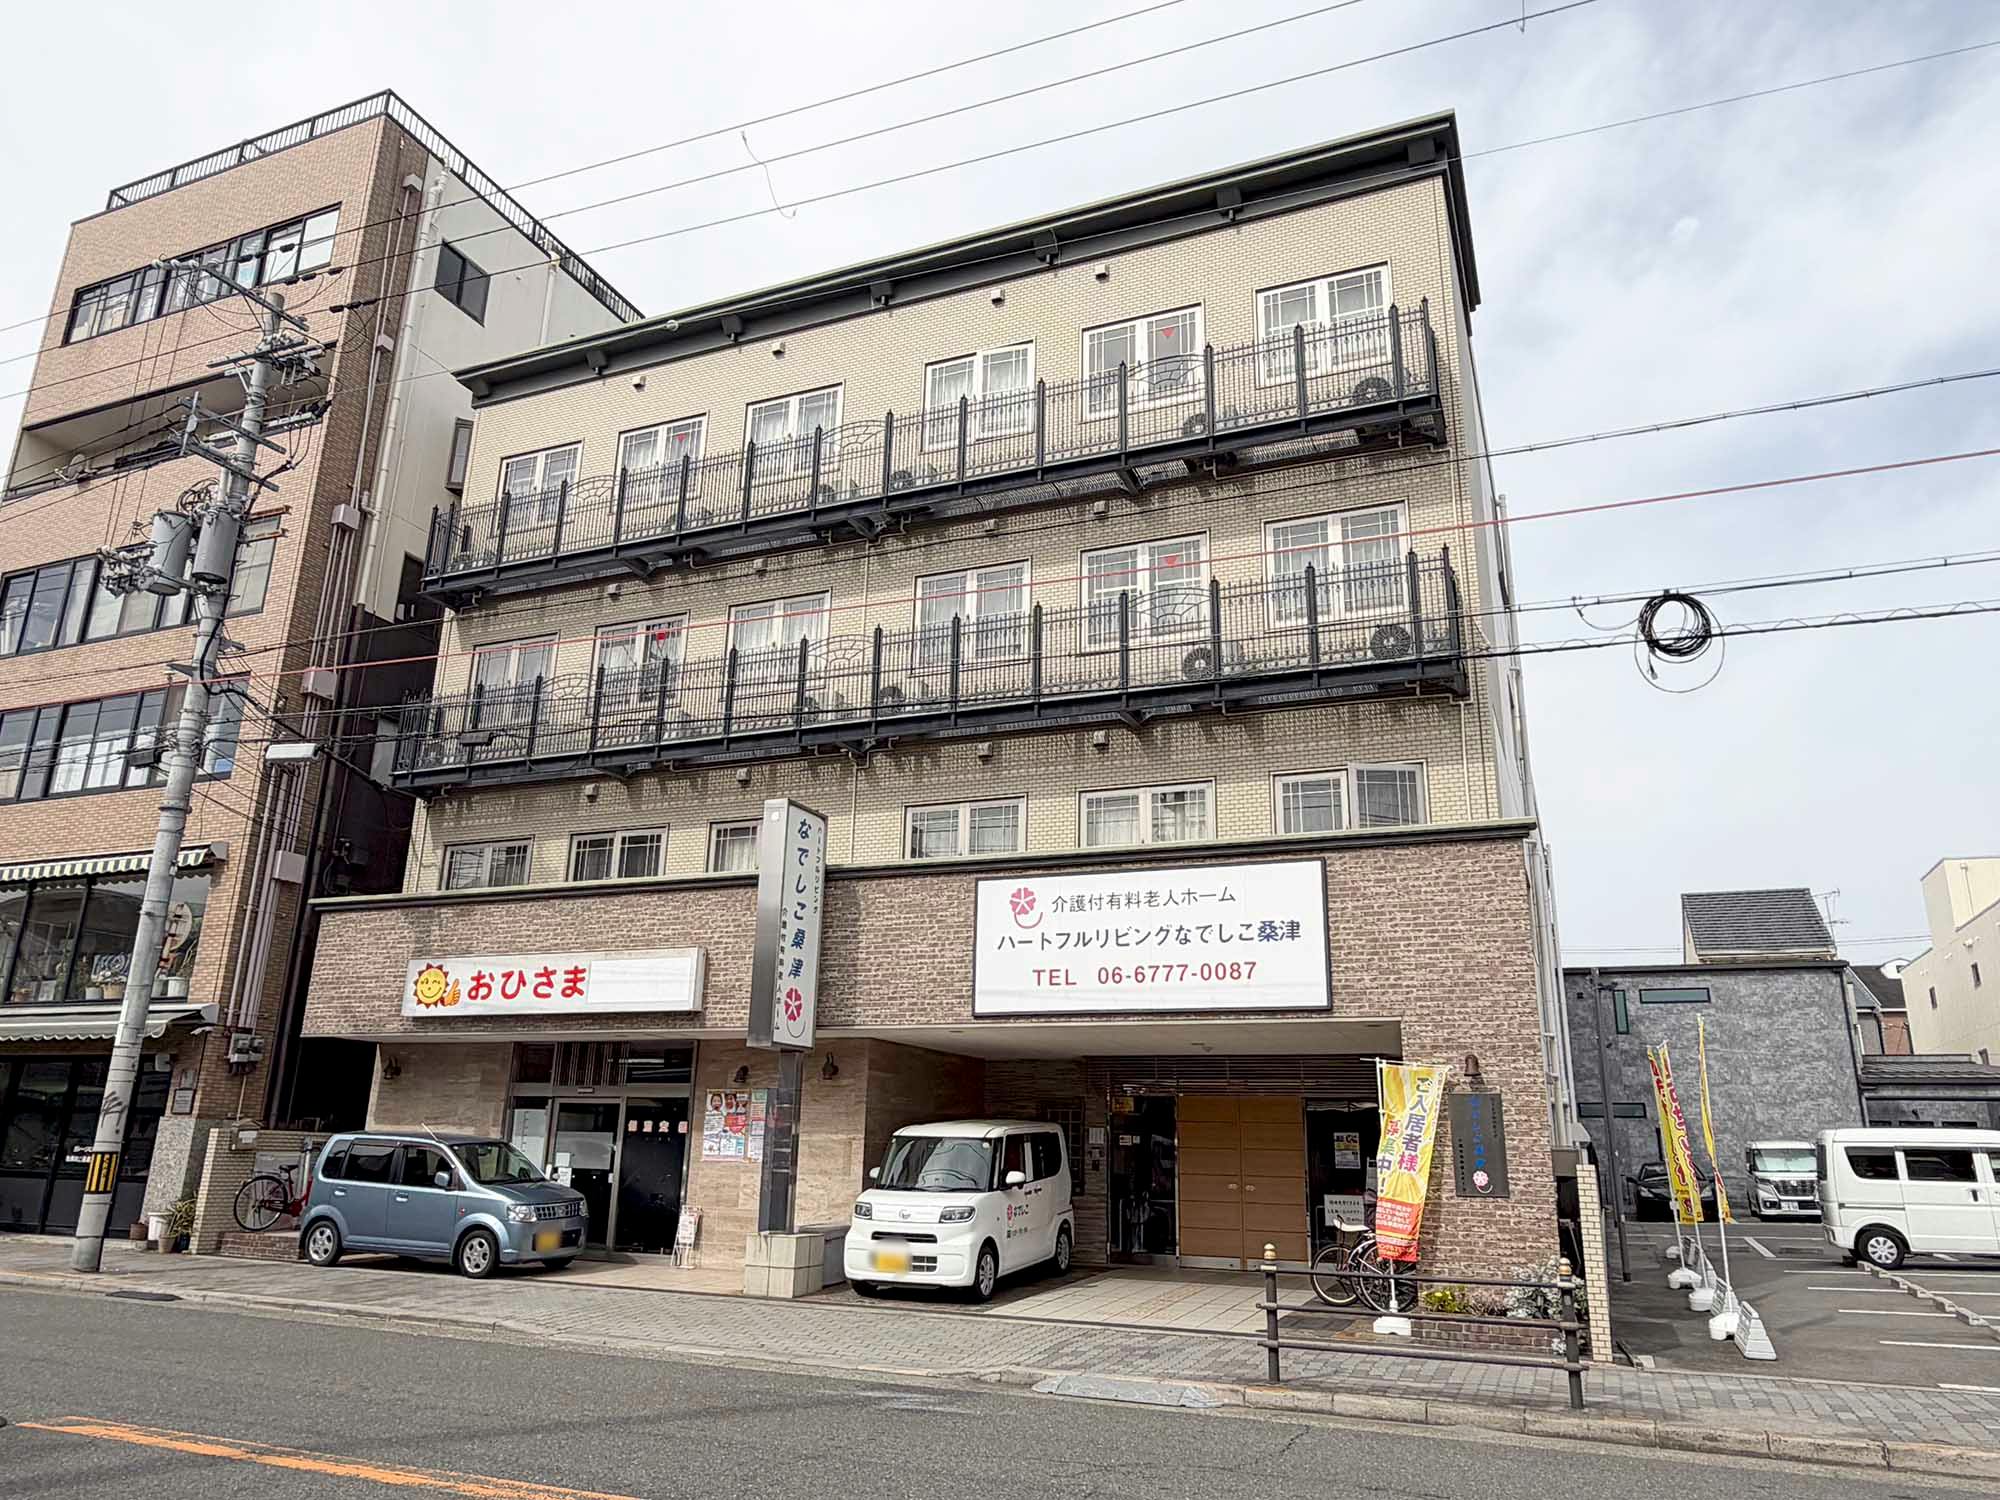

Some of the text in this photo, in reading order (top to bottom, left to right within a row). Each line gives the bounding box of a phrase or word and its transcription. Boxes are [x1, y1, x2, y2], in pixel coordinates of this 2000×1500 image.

[787, 818, 812, 979] なでしこ桑津
[1051, 886, 1236, 913] 介護付有料老人ホーム
[997, 919, 1302, 951] ハートフルリビングなでしこ桑津
[467, 965, 587, 1000] おひさま
[1032, 961, 1257, 986] TEL 06-6777-0087
[1397, 1077, 1433, 1173] ご入居者様
